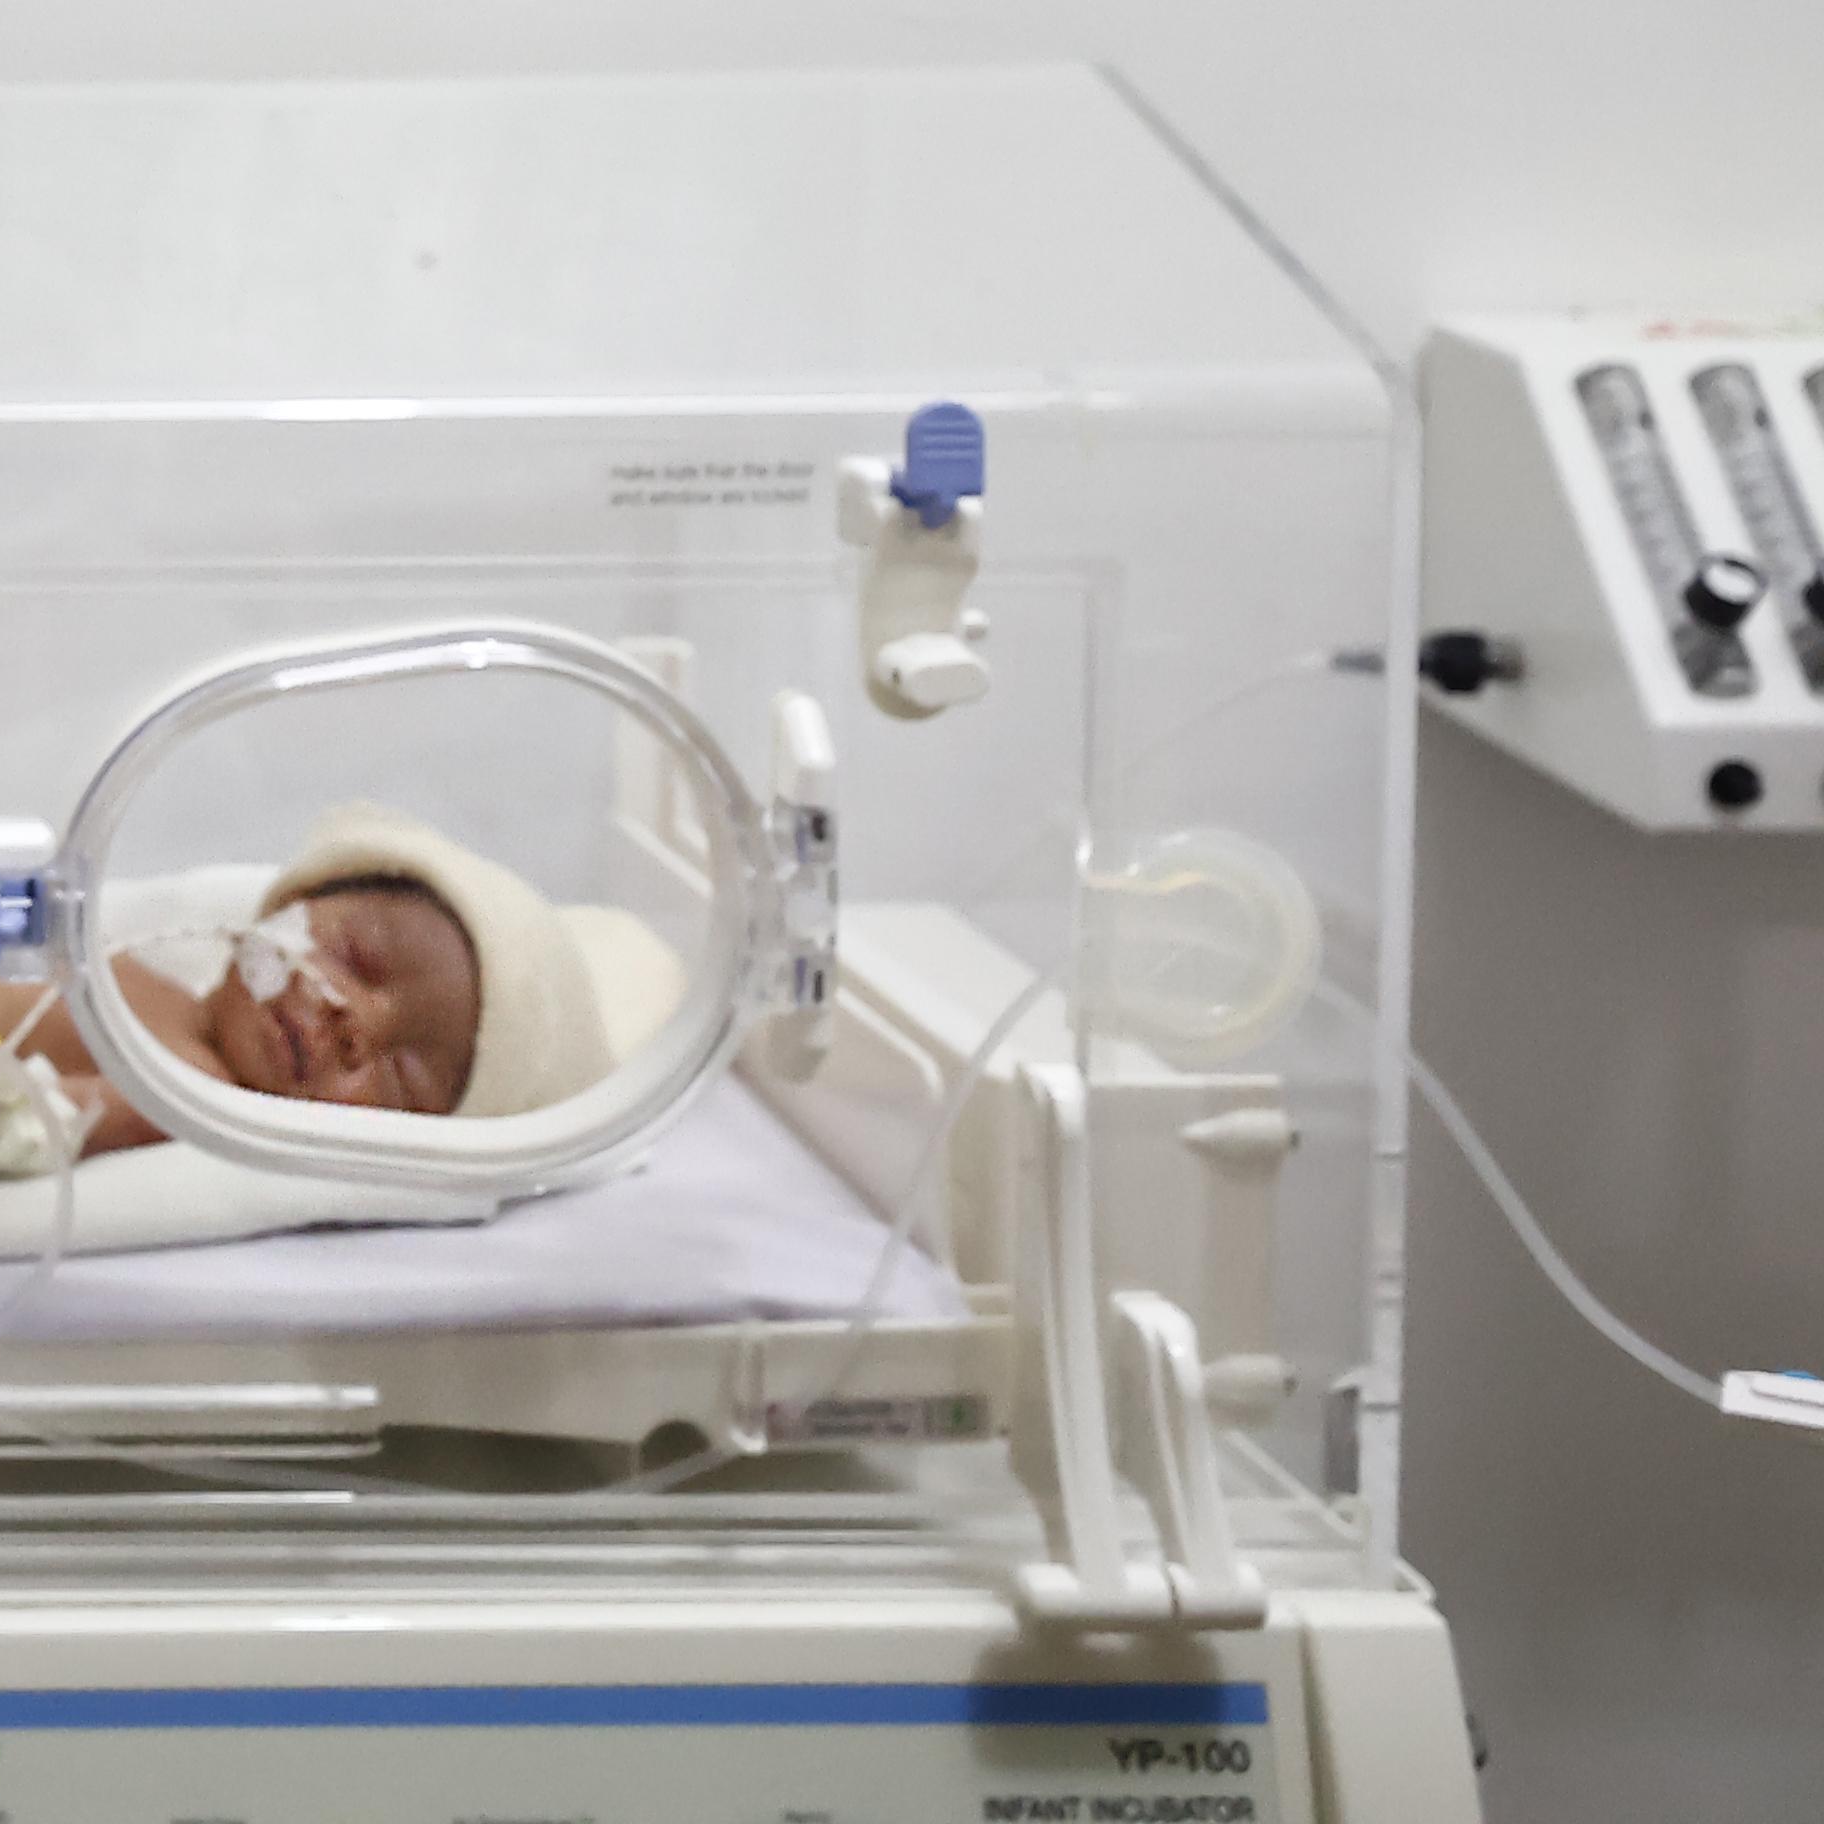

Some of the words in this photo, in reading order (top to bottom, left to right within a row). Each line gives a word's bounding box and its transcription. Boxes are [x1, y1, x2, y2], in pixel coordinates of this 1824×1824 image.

[1108, 1738, 1252, 1773] YP-100
[983, 1796, 1082, 1822] INFANT
[1090, 1796, 1254, 1822] INCUBATOR
